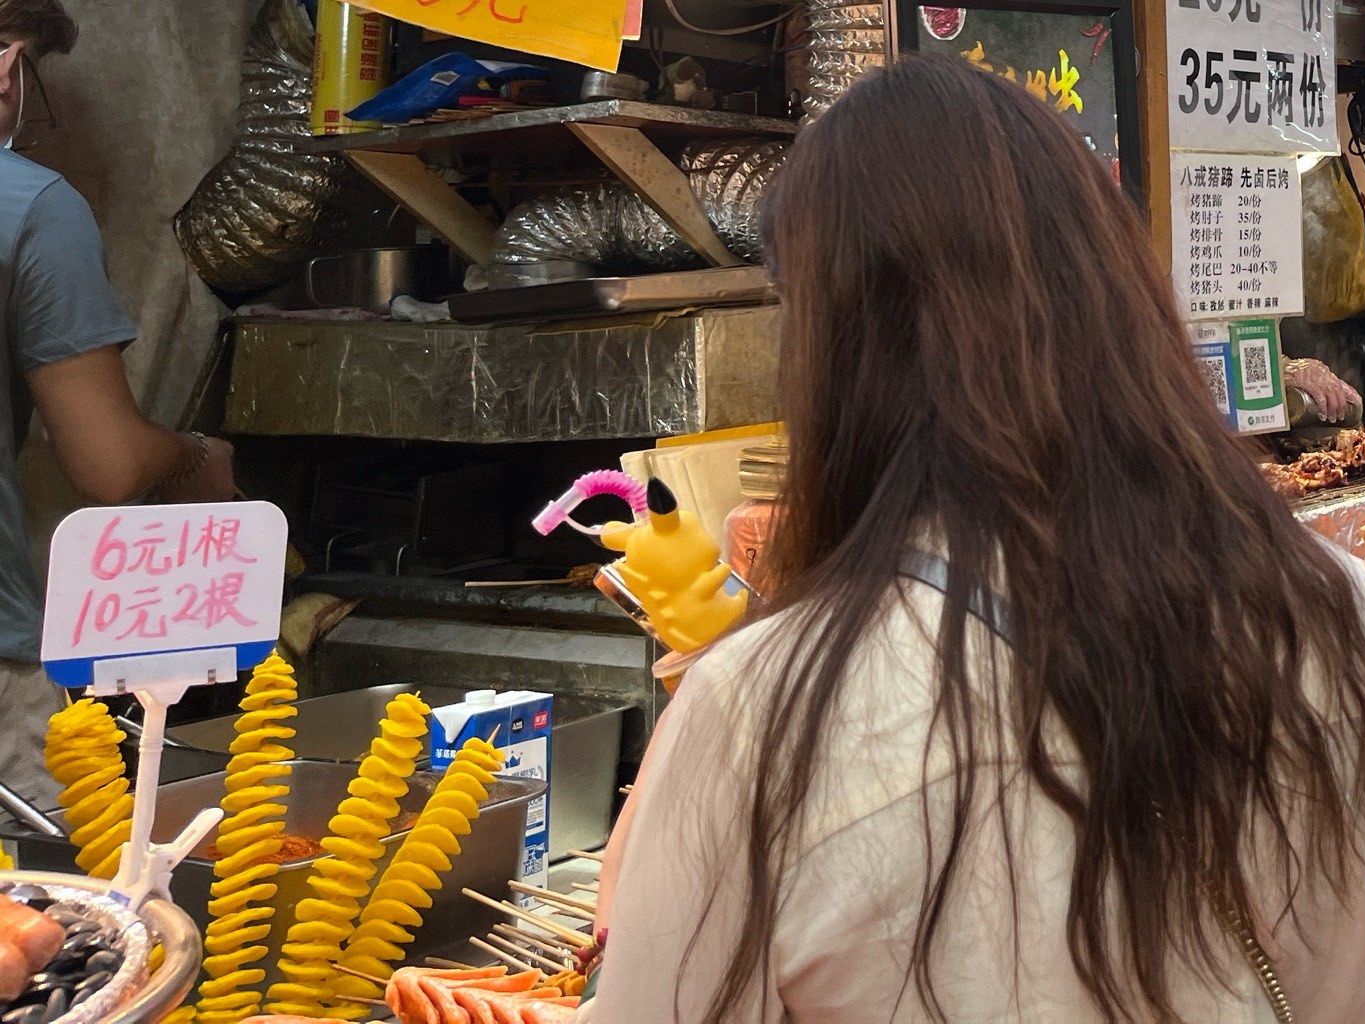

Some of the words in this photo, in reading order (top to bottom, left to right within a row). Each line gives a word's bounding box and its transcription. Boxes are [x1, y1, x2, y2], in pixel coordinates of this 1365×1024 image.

[1178, 48, 1327, 127] 35元两份
[1180, 165, 1233, 189] 八戒猪蹄
[1240, 166, 1289, 190] 先卤后烤
[1191, 194, 1223, 208] 烤猪蹄
[1238, 194, 1262, 208] 20/份
[1191, 211, 1224, 225] 烤肘子
[1238, 211, 1262, 225] 35/份
[1191, 228, 1223, 242] 烤排骨
[1238, 227, 1262, 242] 15/份
[1191, 245, 1223, 260] 烤鸡爪
[1238, 244, 1262, 258] 10/份
[1191, 262, 1223, 277] 烤尾巴
[1230, 260, 1278, 275] 20-40不等
[1191, 280, 1223, 295] 烤猪头
[1238, 278, 1262, 292] 40/份
[91, 516, 258, 580] 6元1根
[73, 573, 258, 647] 10元2根
